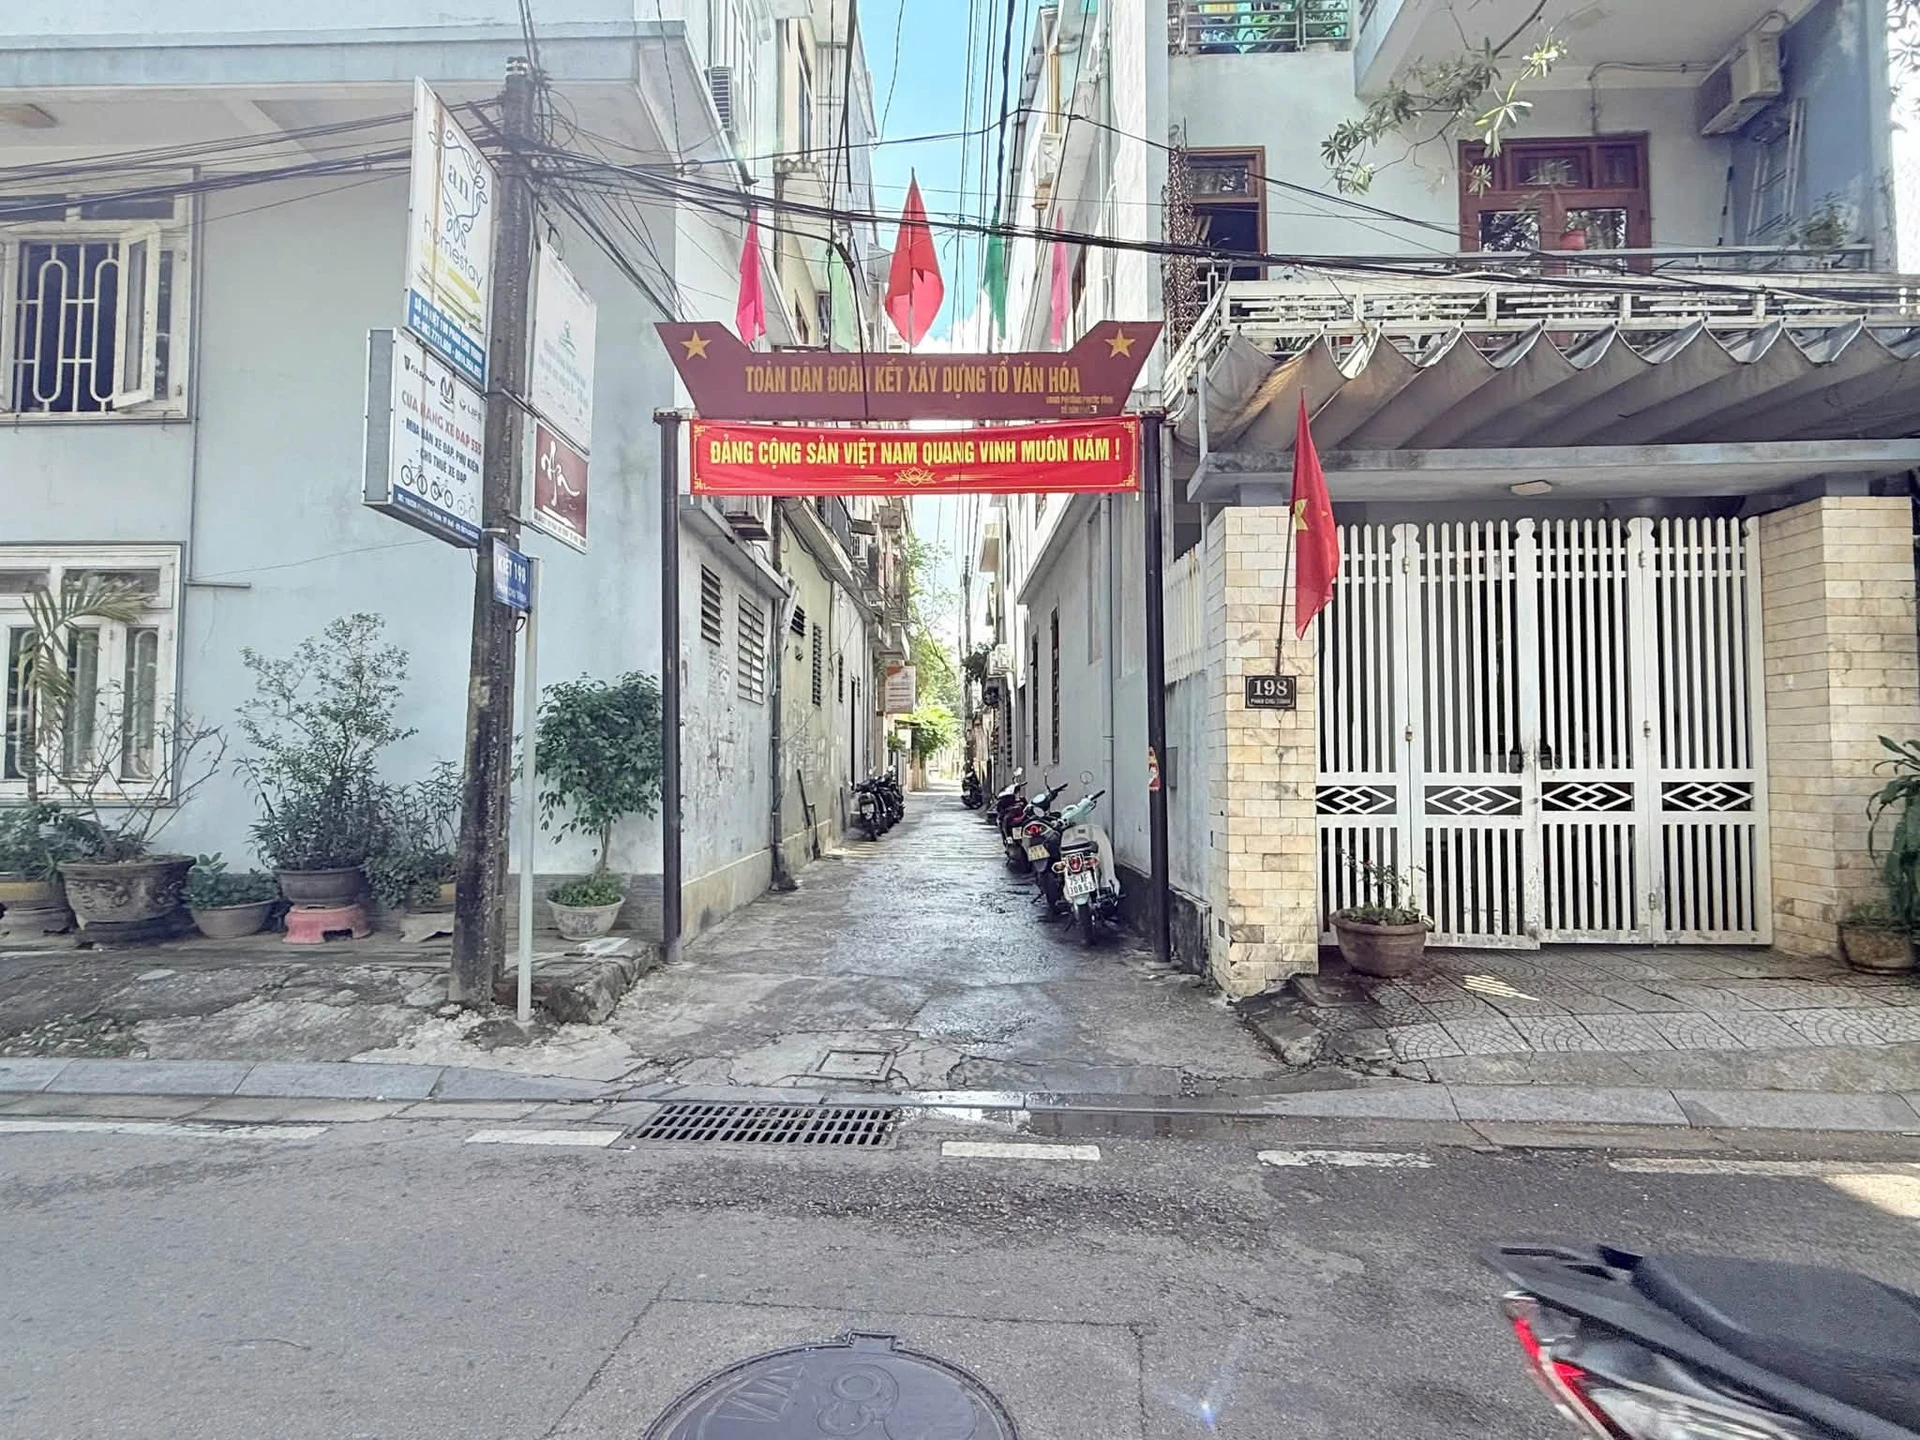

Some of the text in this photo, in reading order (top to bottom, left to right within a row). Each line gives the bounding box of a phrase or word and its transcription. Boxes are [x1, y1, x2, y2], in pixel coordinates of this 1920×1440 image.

[423, 211, 484, 290] homestay
[745, 360, 786, 393] TOÀN
[791, 361, 823, 393] DÂN
[827, 360, 870, 393] ĐOÀN
[875, 358, 904, 393] KẾT
[908, 361, 937, 393] XÂY
[942, 363, 986, 399] DỰNG
[990, 356, 1009, 393] TỔ
[1012, 361, 1044, 393] VĂN
[710, 434, 753, 464] ĐẢNG
[758, 438, 801, 469] CỘNG
[806, 435, 839, 464] SẢN
[844, 438, 876, 469] VIỆT
[881, 442, 917, 464] NAM
[922, 441, 975, 466] QUANG
[979, 441, 1016, 463] VINH
[1021, 435, 1068, 463] MUÔN
[1072, 433, 1109, 462] NĂM
[1253, 679, 1288, 696] 198
